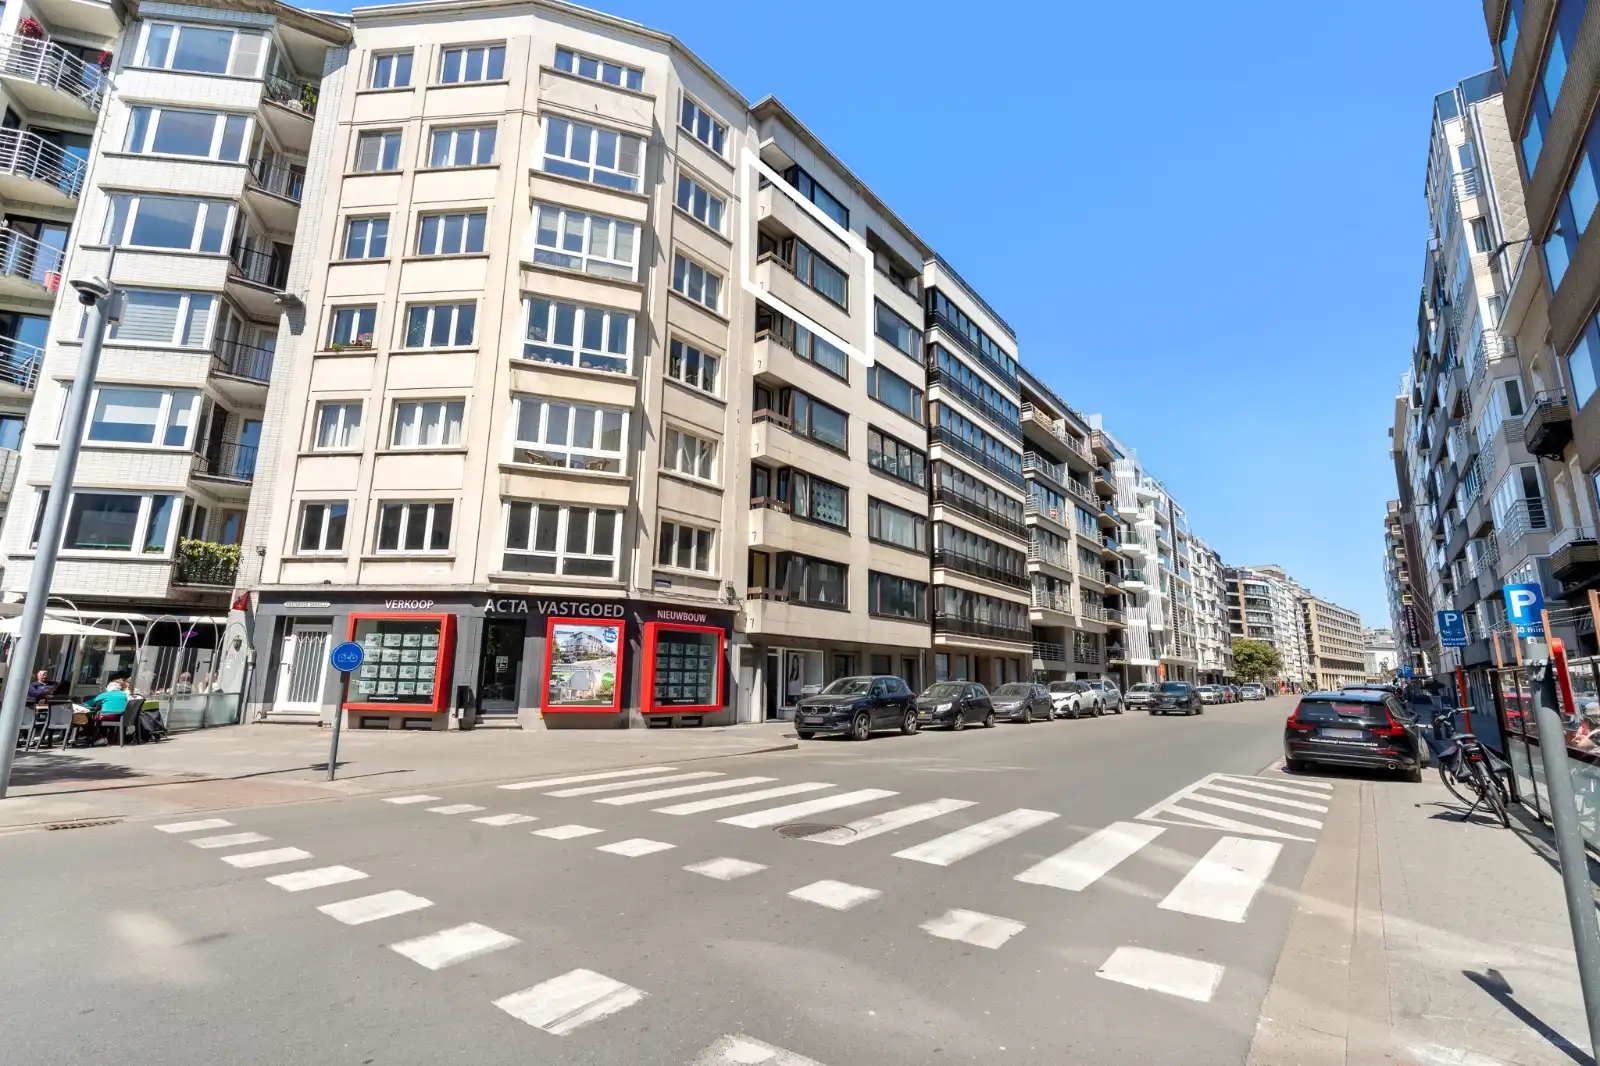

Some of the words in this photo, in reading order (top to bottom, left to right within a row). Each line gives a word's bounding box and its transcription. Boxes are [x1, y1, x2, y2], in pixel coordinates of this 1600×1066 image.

[385, 599, 434, 609] VERKOOP
[484, 598, 529, 614] ACTA
[537, 600, 625, 618] VASTGOED
[1509, 589, 1537, 618] P
[656, 609, 707, 623] NIEUWBOUW
[1444, 612, 1458, 627] P
[1527, 625, 1544, 633] min
